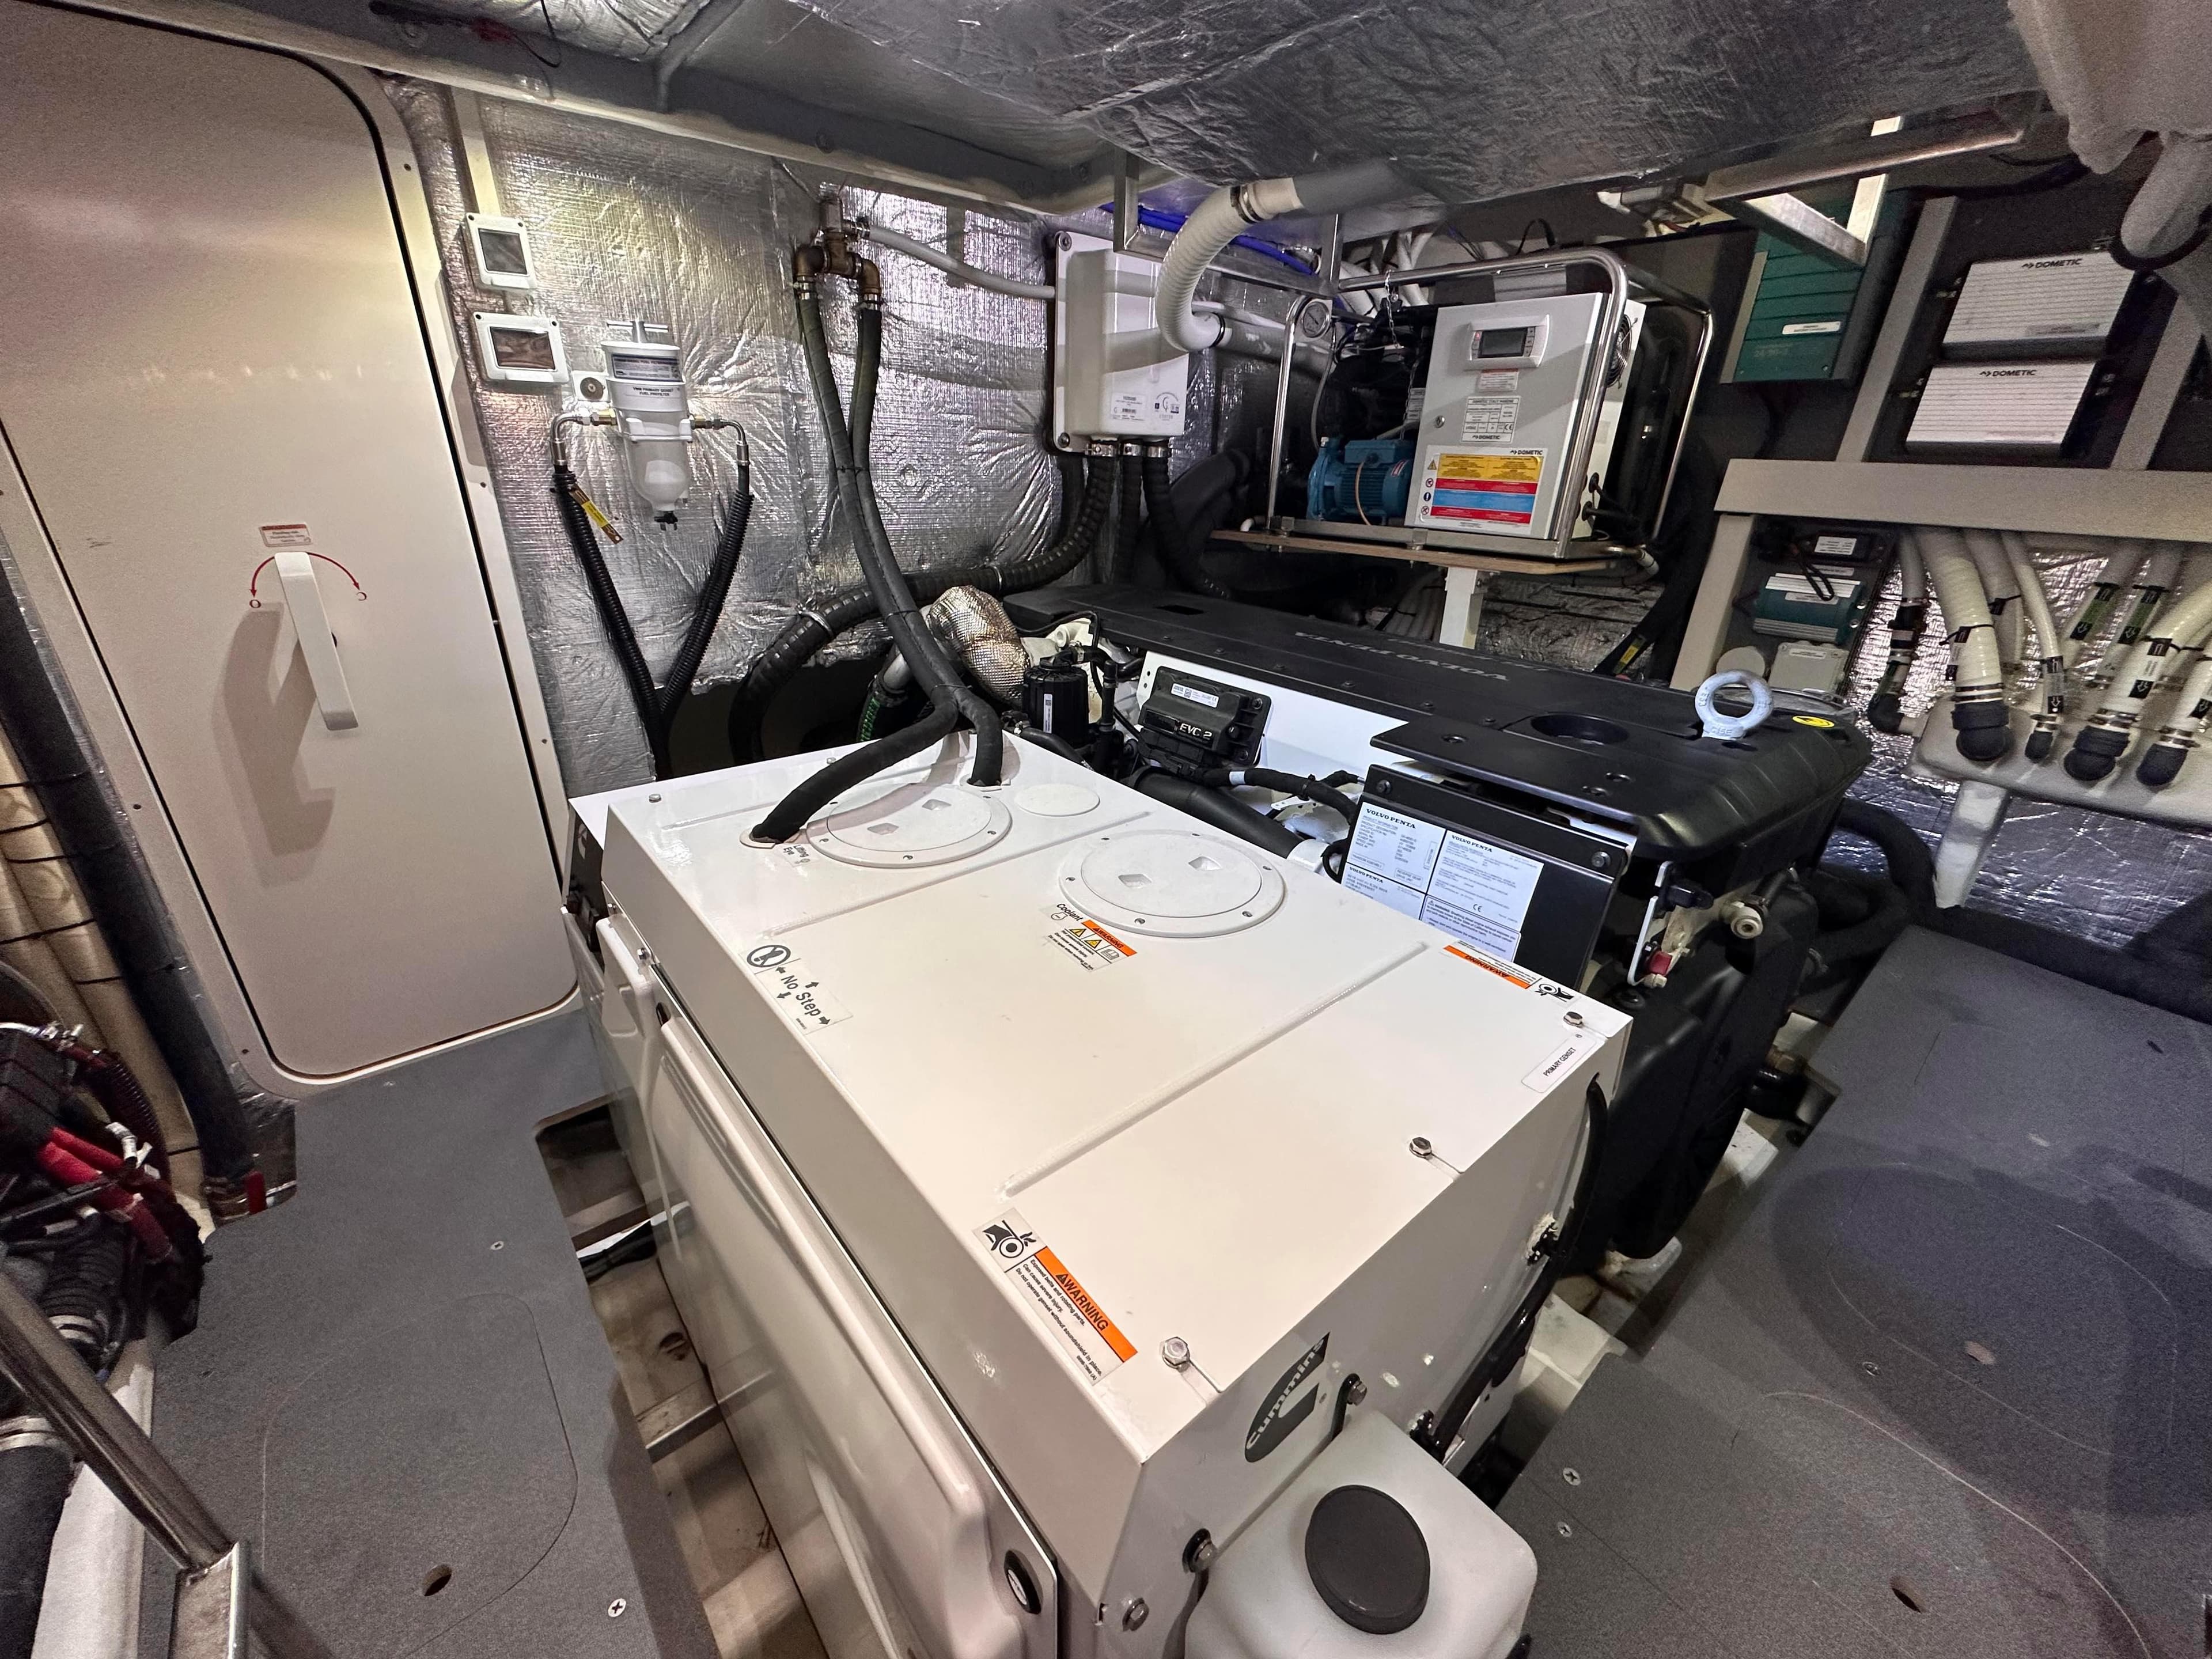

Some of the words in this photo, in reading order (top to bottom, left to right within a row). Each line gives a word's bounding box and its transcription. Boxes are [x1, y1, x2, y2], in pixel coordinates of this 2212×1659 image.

[2035, 258, 2083, 268] DOMETIC
[1295, 632, 1395, 654] PENTA
[1397, 654, 1508, 681] VOLVO
[1179, 723, 1202, 736] EVC
[1203, 730, 1213, 739] 2
[1367, 809, 1389, 819] VOLVO
[1390, 817, 1415, 829] PENTA
[1452, 835, 1471, 844] VOLVO
[1472, 843, 1492, 852] PENTA
[1350, 867, 1365, 876] VOLVO
[1366, 874, 1382, 883] PENTA
[1056, 903, 1083, 921] Coolant
[781, 975, 798, 990] No
[796, 992, 821, 1016] Step
[1543, 1060, 1562, 1076] PRIMARY
[1559, 1047, 1575, 1061] GENSET
[1030, 1272, 1041, 1285] cause
[1040, 1285, 1052, 1299] severe
[1051, 1299, 1063, 1312] injury.
[1031, 1259, 1046, 1277] Exposed
[1045, 1277, 1054, 1287] belts
[1054, 1287, 1062, 1296] and
[1060, 1296, 1075, 1313] rotating
[1073, 1313, 1085, 1326] parts.
[1063, 1279, 1108, 1331] WARNING
[1027, 1282, 1040, 1297] operate
[1038, 1298, 1052, 1312] genset
[1051, 1312, 1065, 1328] without
[1063, 1328, 1088, 1355] soundshield
[1089, 1361, 1101, 1376] place.
[1246, 1339, 1324, 1450] Cummins
